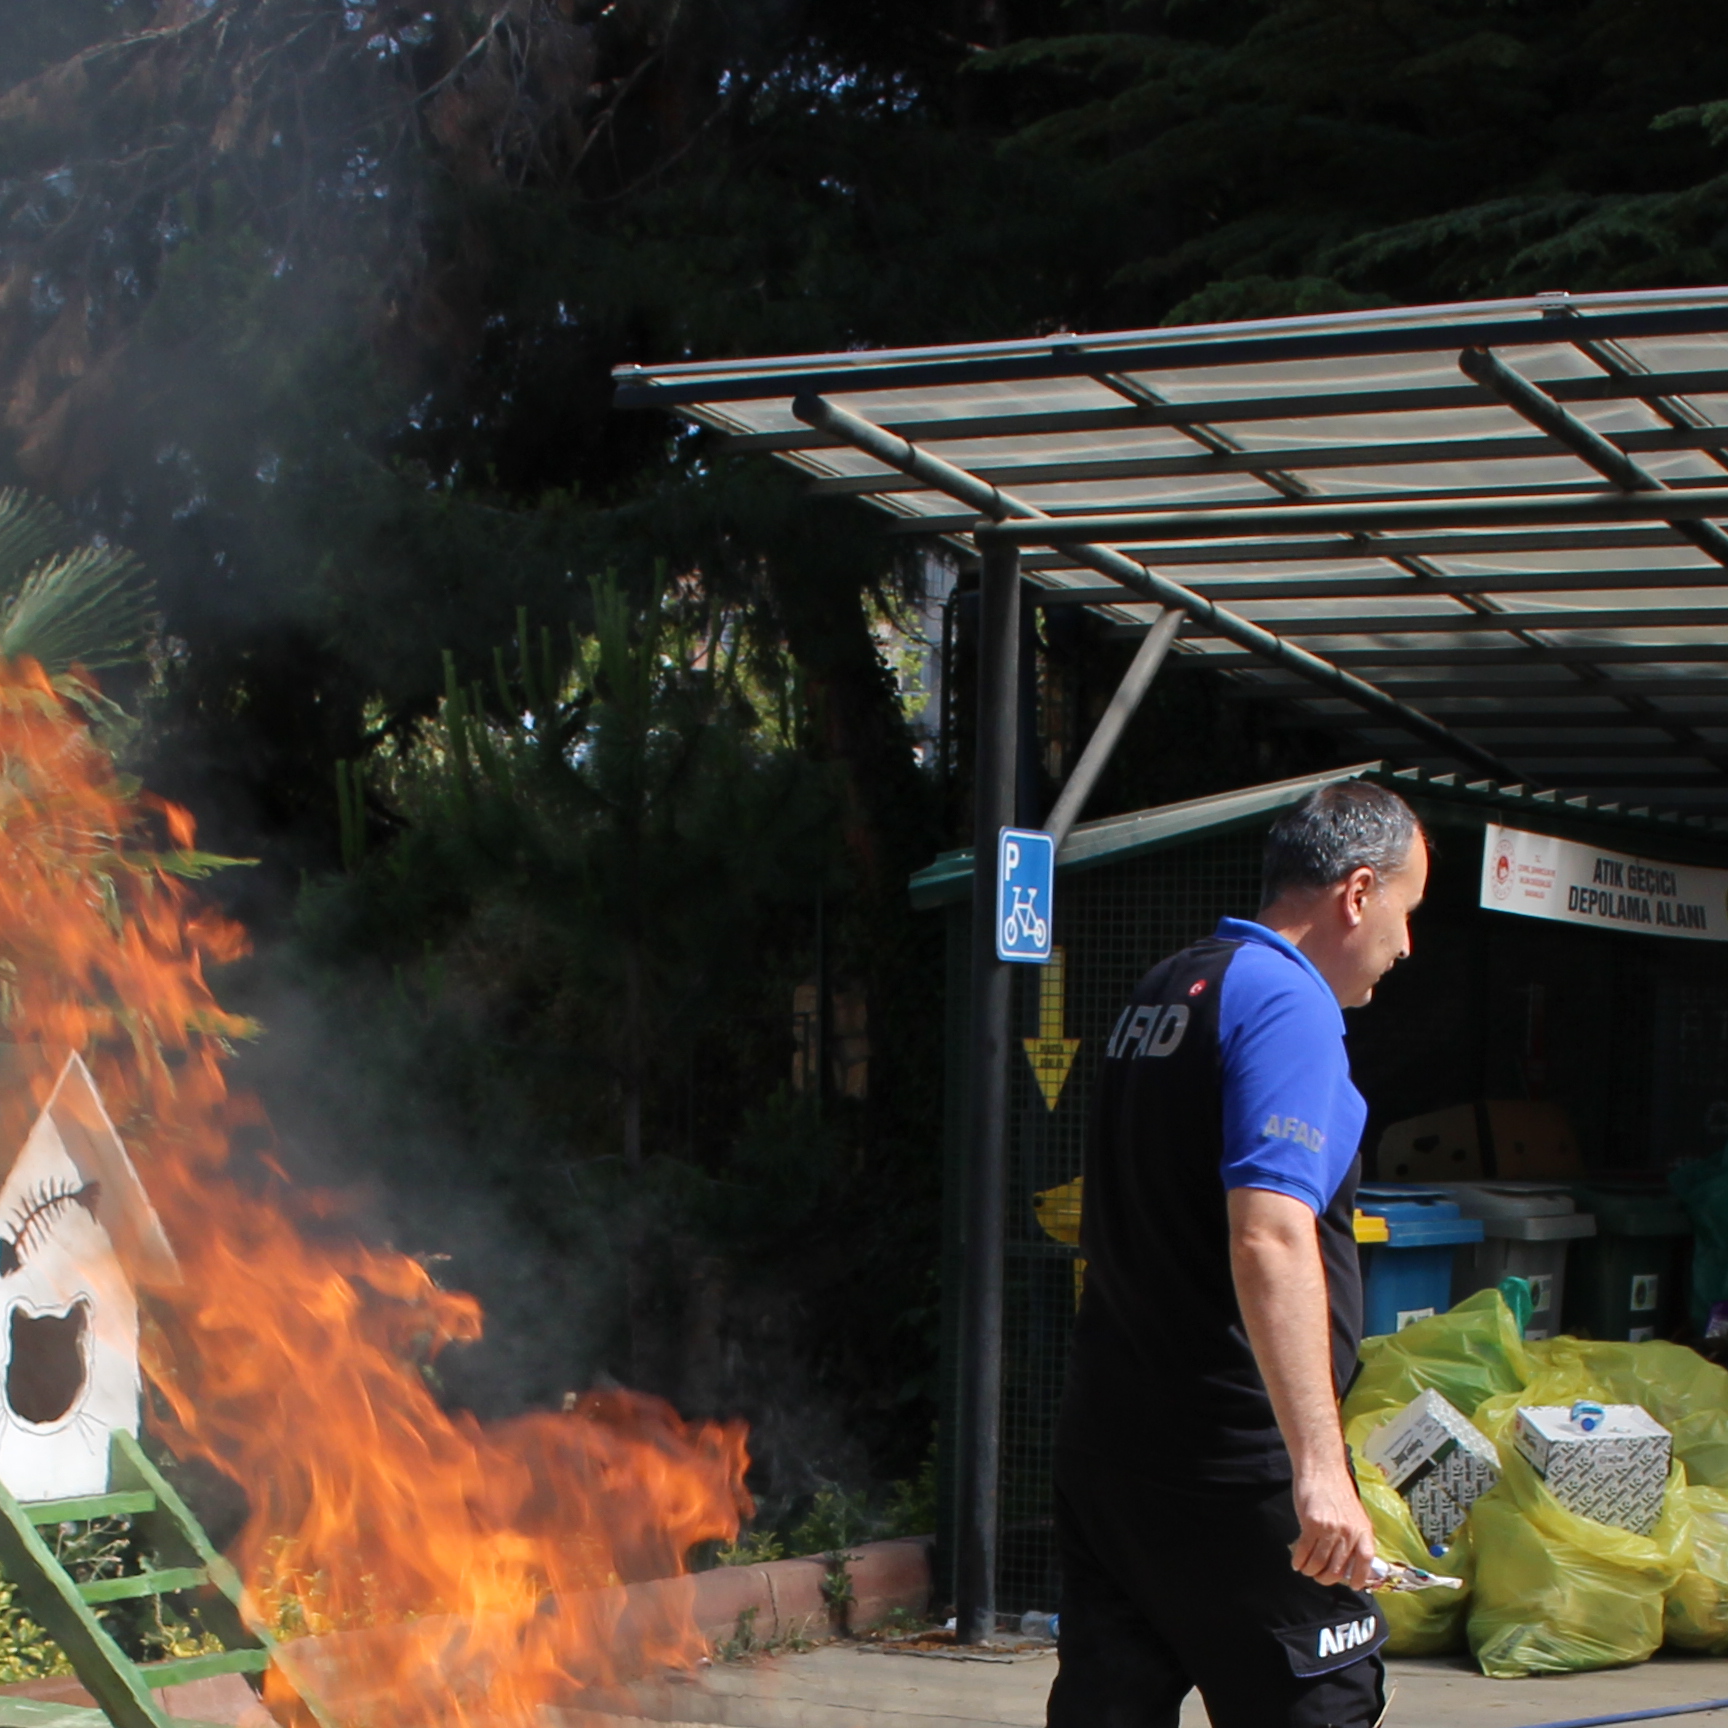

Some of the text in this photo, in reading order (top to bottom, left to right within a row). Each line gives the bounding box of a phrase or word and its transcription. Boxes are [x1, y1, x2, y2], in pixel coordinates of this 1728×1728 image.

[1005, 842, 1019, 881] P
[1593, 857, 1625, 887] ATIK
[1568, 885, 1707, 930] DEPOLAMA ALANI
[1262, 1114, 1323, 1154] AFAD
[1318, 1615, 1376, 1658] AFAD
